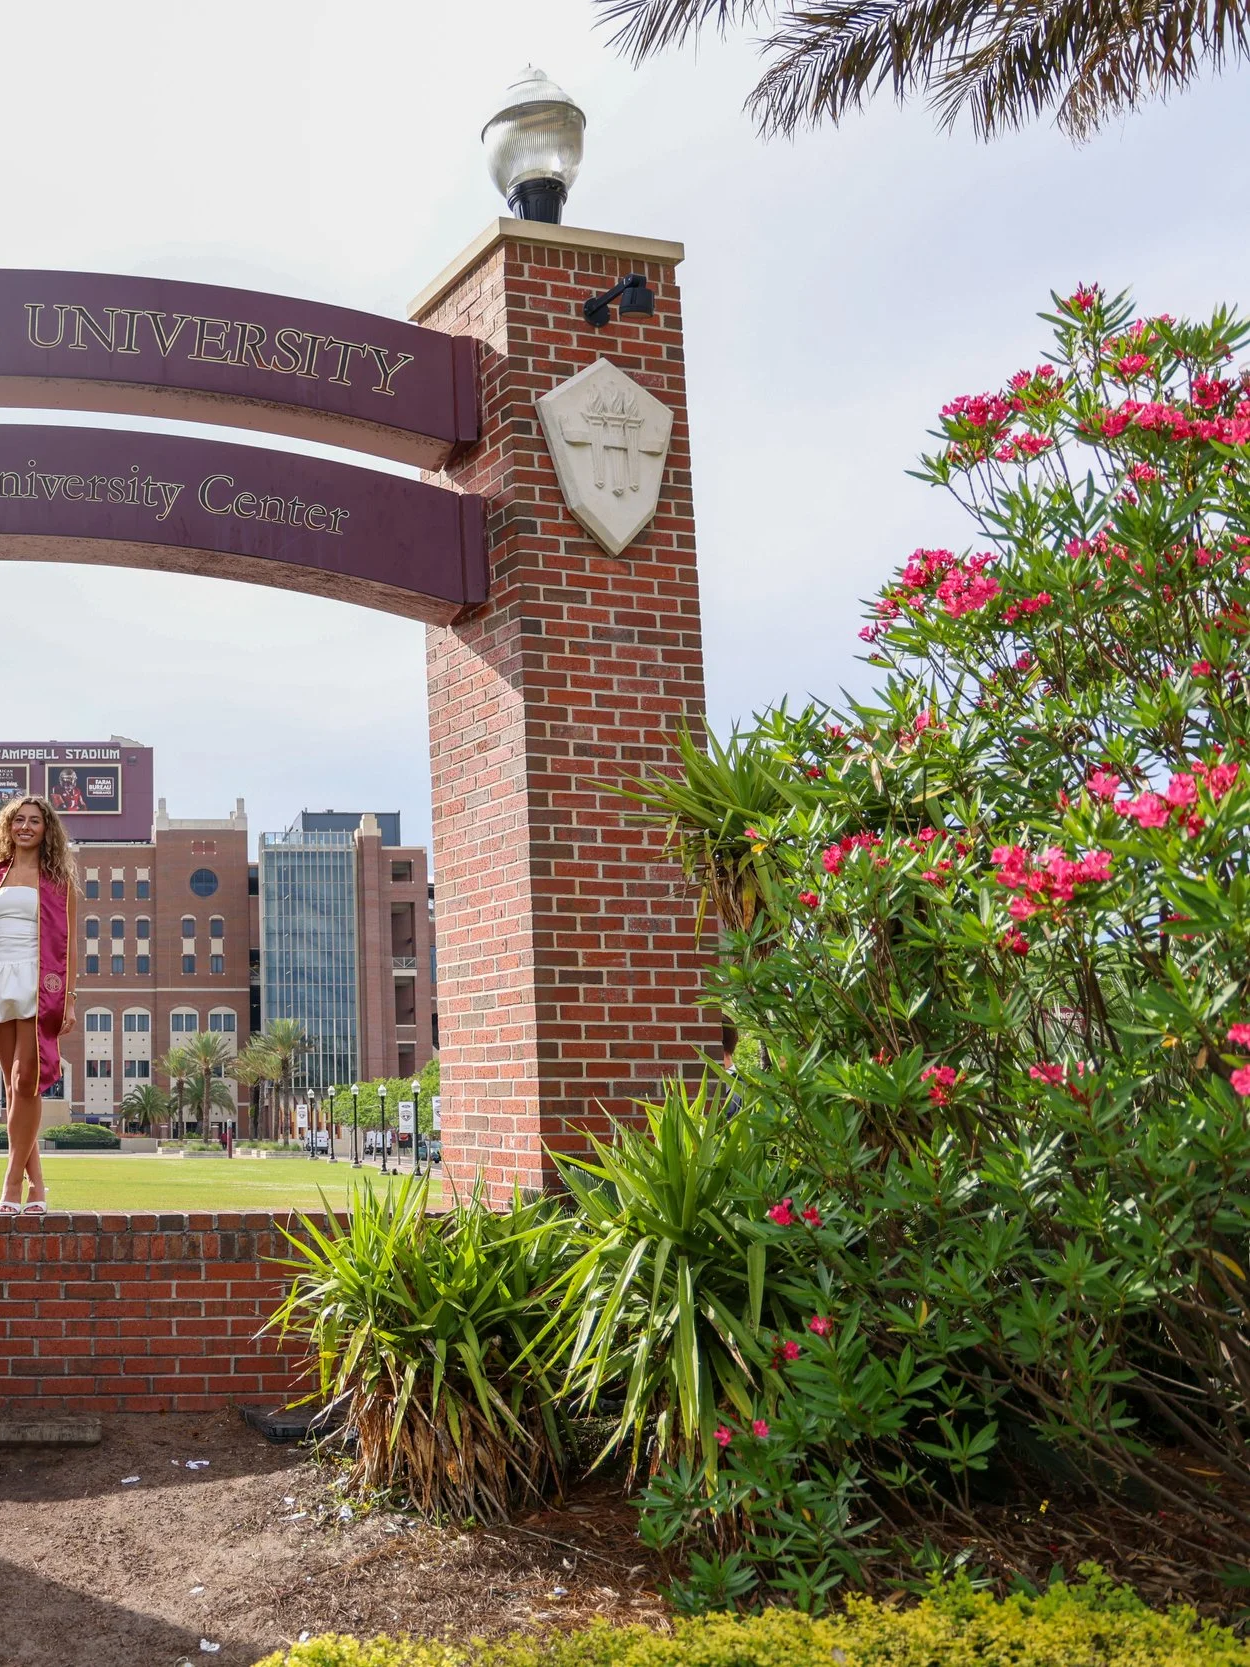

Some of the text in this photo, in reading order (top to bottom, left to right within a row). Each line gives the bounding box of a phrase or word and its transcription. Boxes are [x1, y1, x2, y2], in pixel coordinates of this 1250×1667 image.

[23, 303, 415, 396] UNIVERSITY
[198, 474, 351, 535] Center
[65, 749, 120, 760] STADIUM
